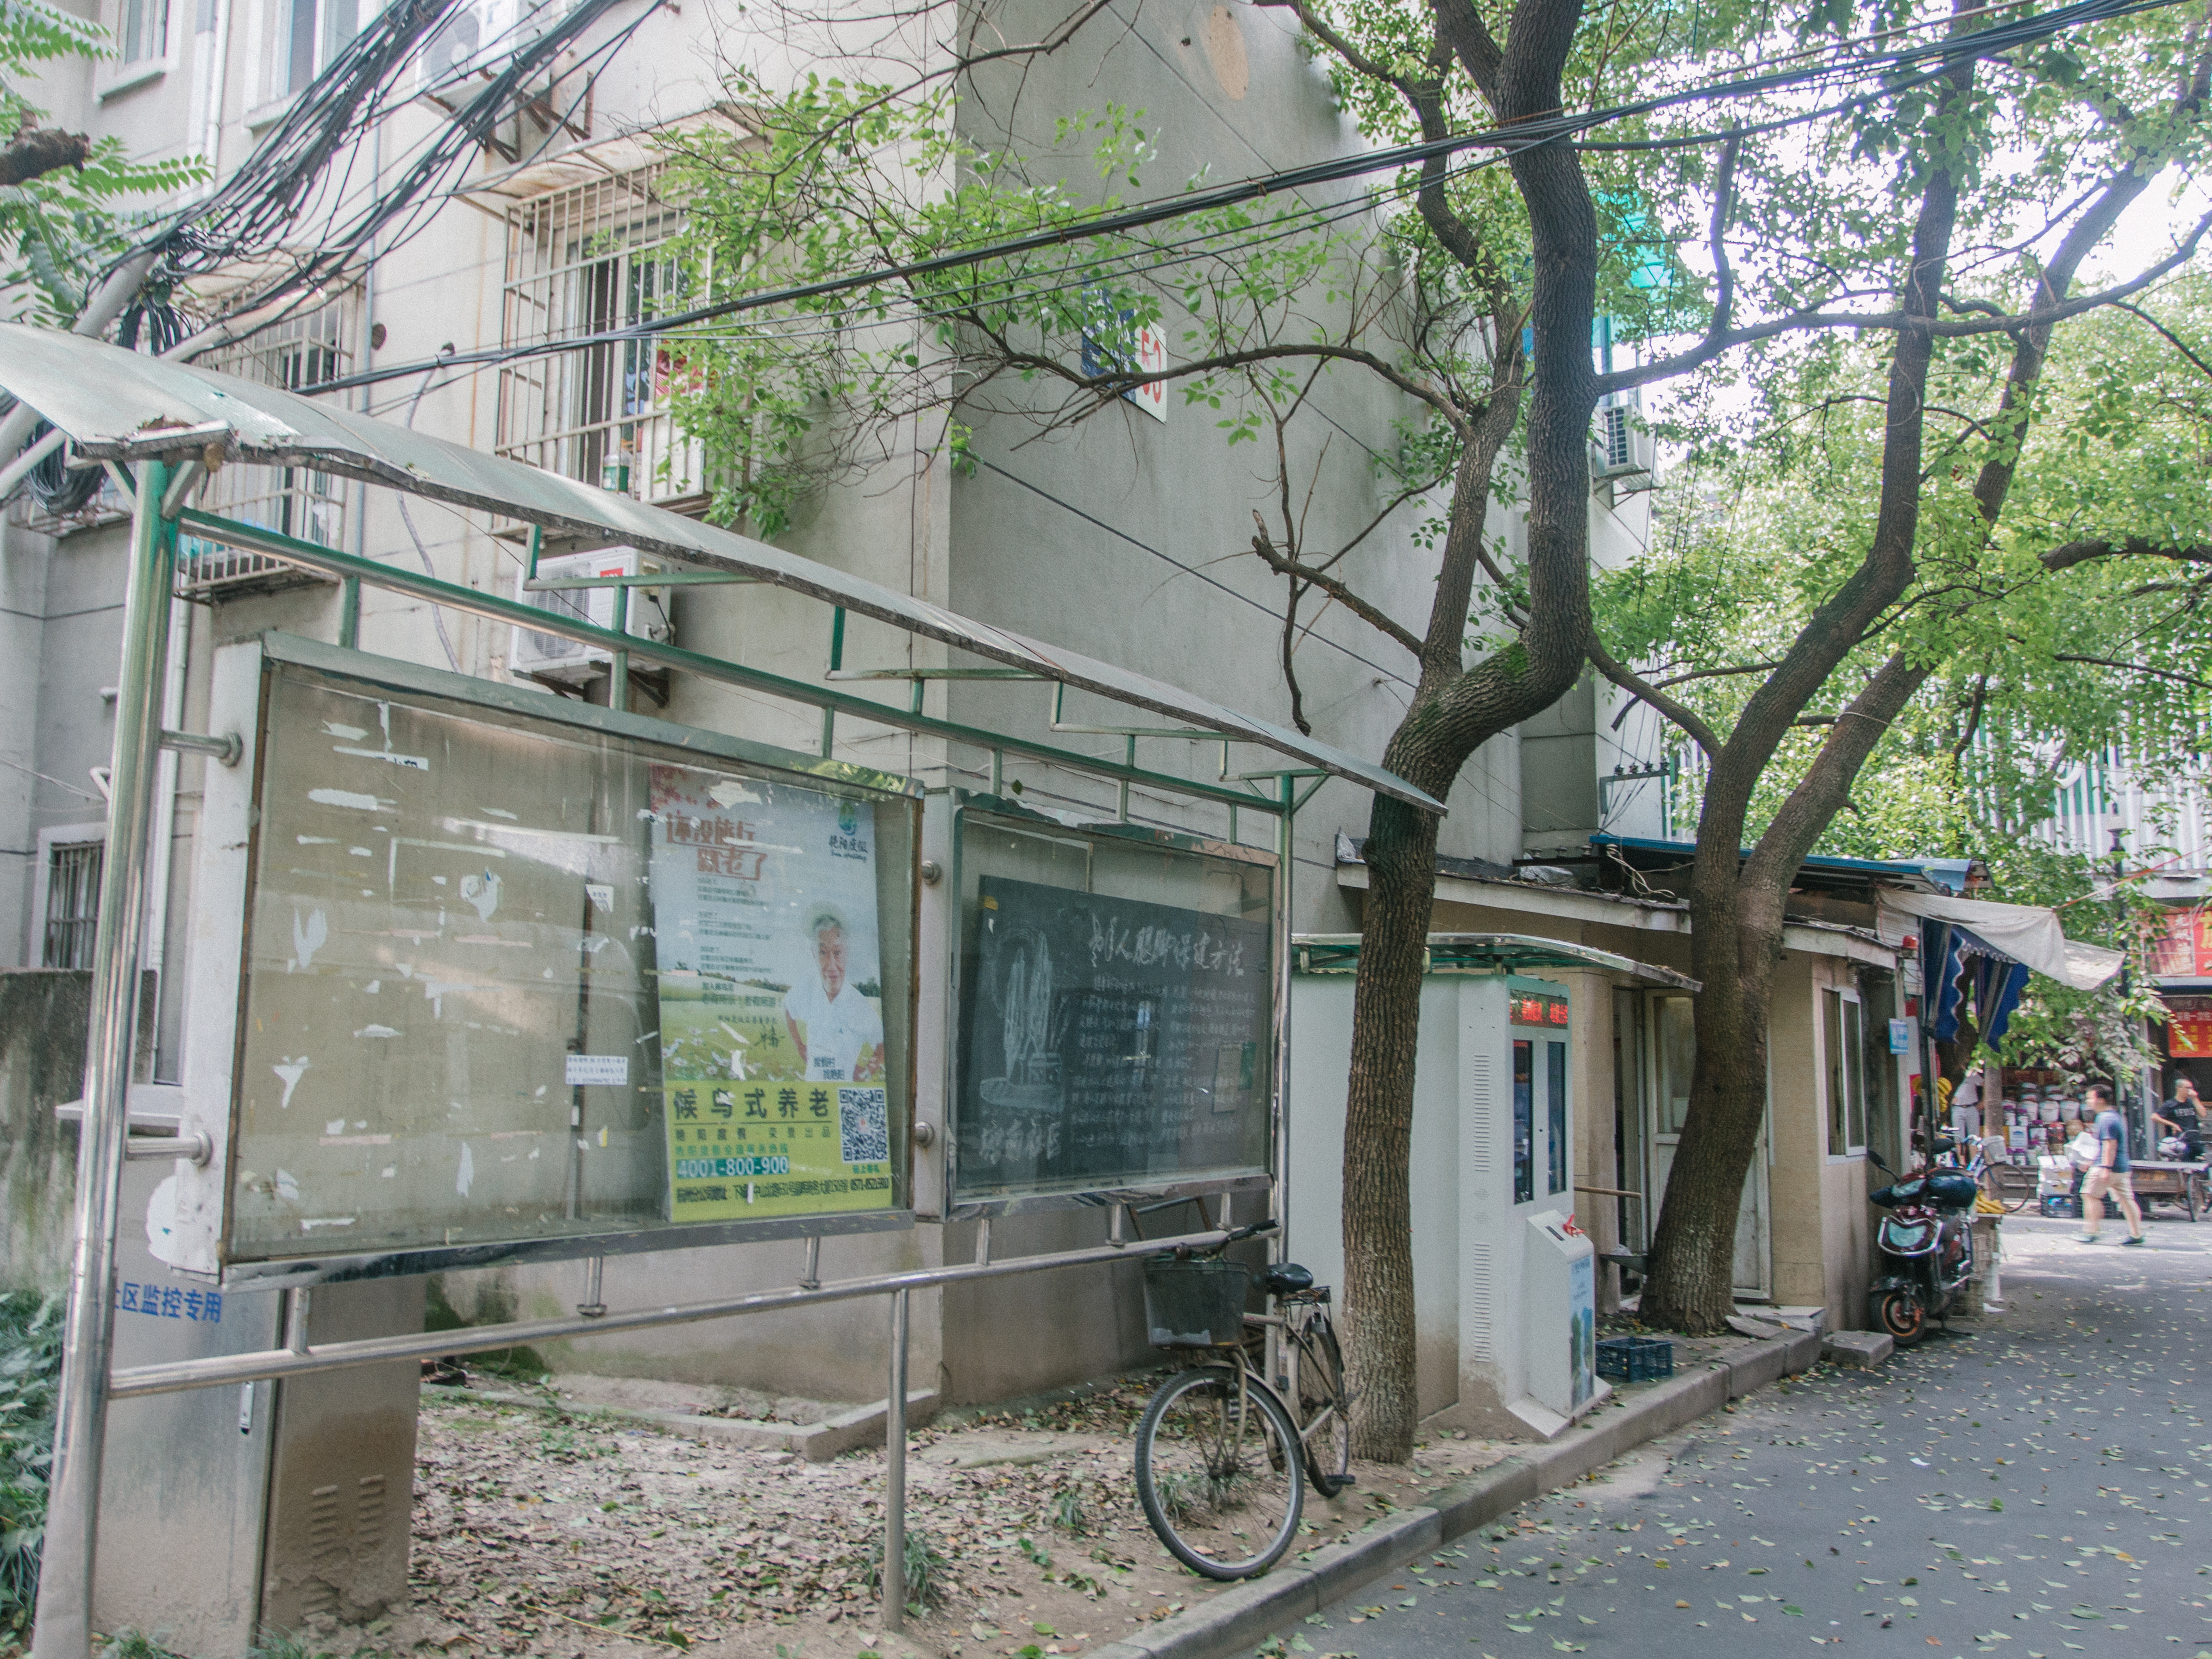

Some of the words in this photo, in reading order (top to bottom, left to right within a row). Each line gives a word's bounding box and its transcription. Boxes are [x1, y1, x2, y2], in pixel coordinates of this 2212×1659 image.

[673, 1088, 829, 1119] 候鸟式养老
[677, 1156, 789, 1177] 4001-800-900
[115, 1282, 221, 1323] 区监控专用
